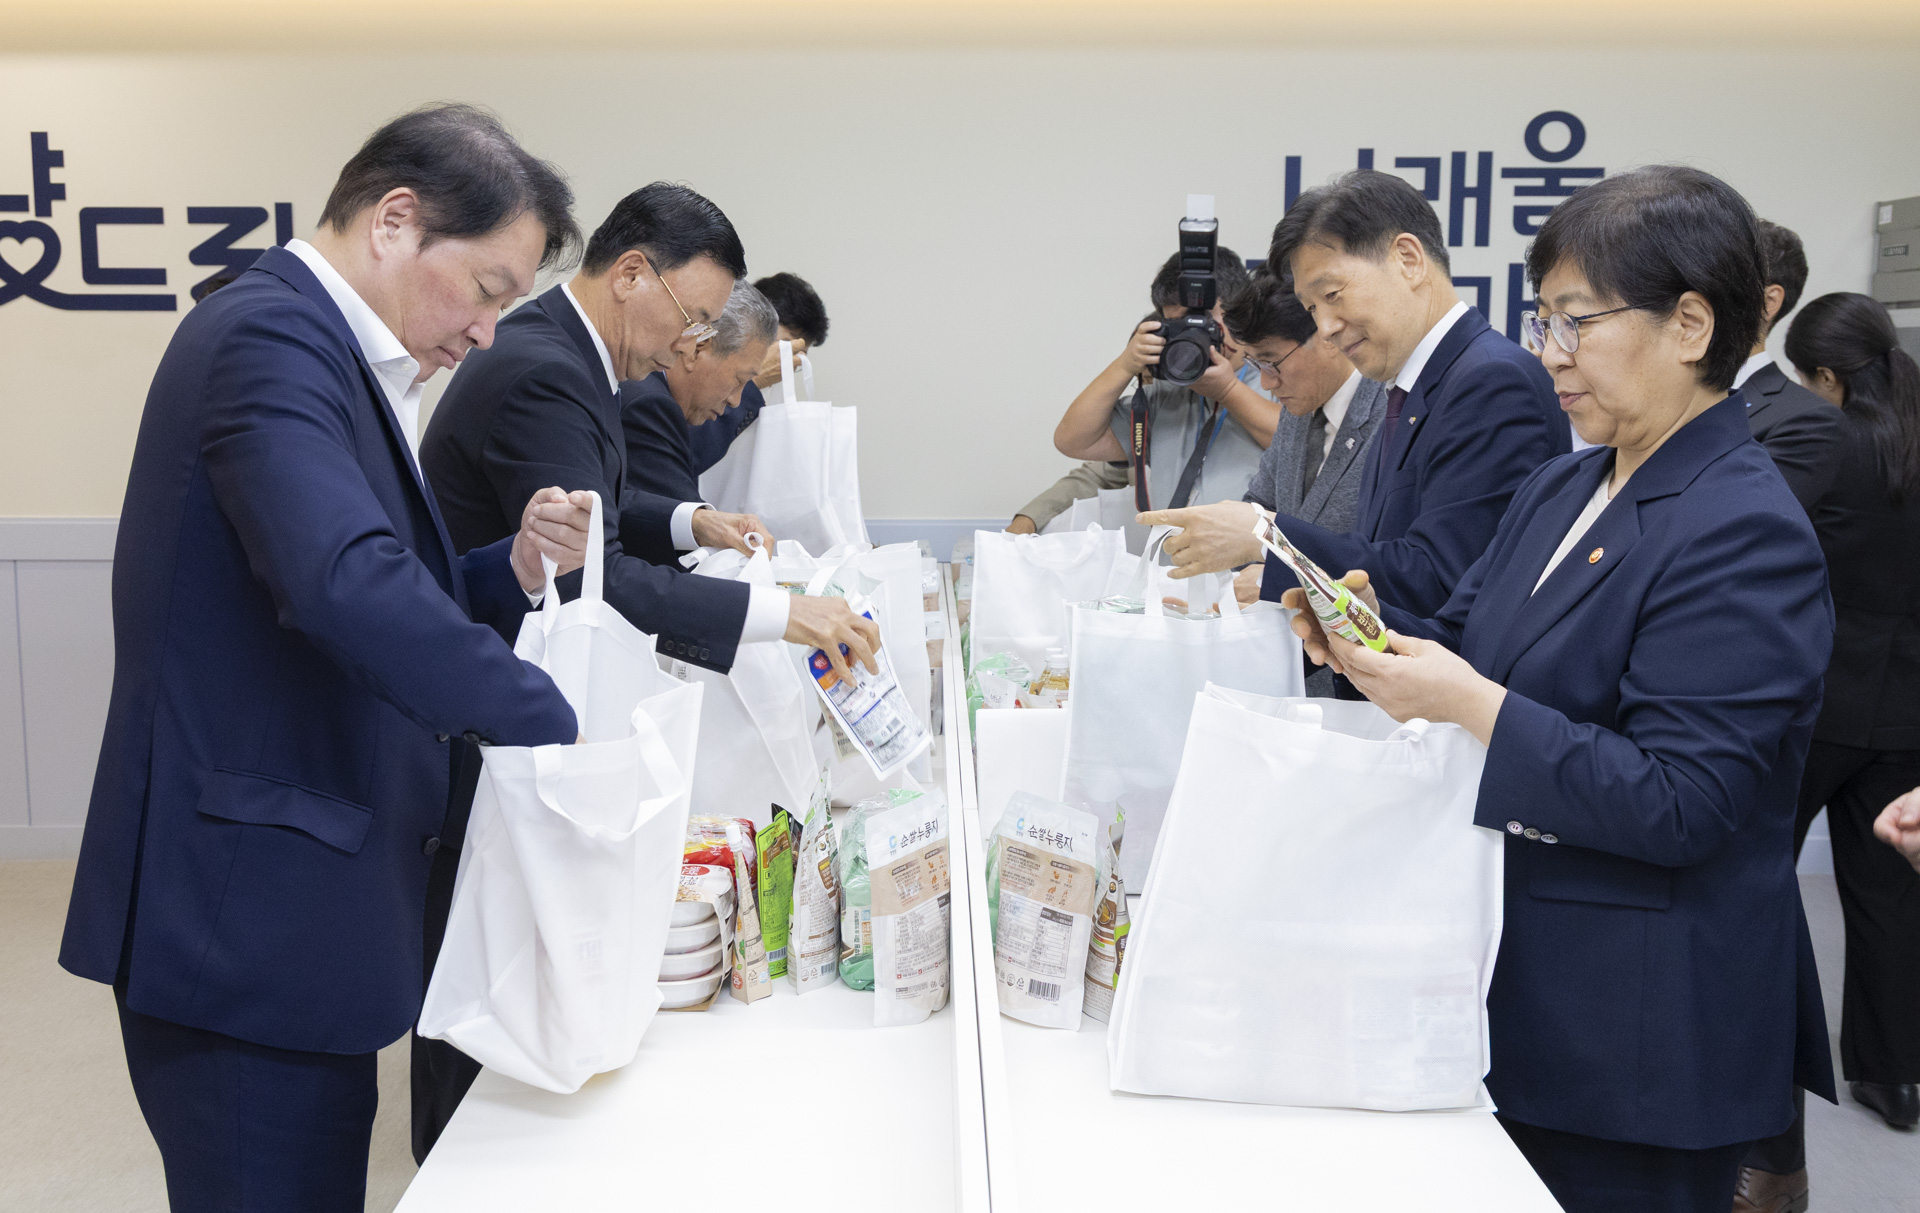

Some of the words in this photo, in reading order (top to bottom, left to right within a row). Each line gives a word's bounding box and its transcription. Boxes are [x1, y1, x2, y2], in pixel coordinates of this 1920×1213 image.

[1284, 110, 1606, 247] 래울
[1134, 422, 1143, 456] Canon
[900, 817, 939, 848] 순쌀누룽지
[1027, 824, 1074, 853] 순쌀누룽지
